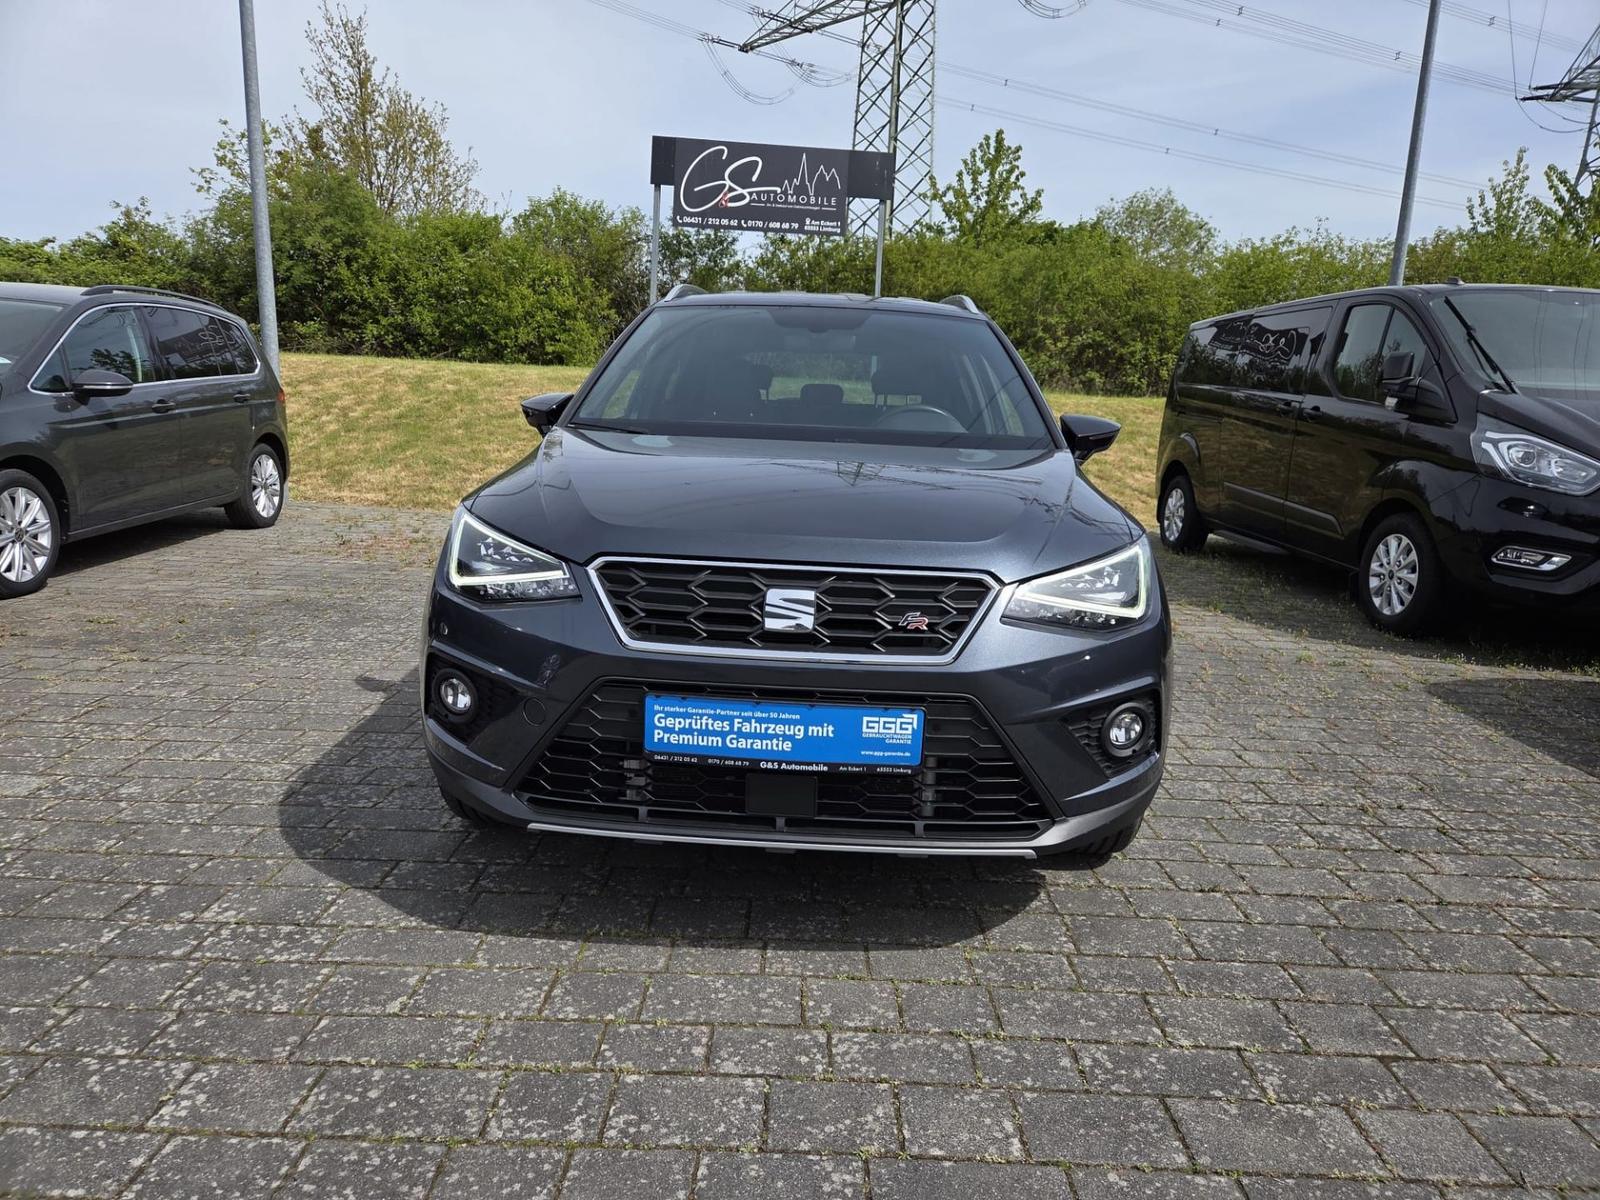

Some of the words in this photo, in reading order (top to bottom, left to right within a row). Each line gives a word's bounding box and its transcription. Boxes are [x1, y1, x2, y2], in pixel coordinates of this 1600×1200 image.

[751, 192, 838, 206] AUTOMOBILE
[683, 215, 702, 224] 06431
[708, 217, 720, 225] 212
[720, 218, 729, 226] 05
[747, 219, 763, 228] 0170
[898, 611, 929, 631] FR
[654, 704, 663, 712] Ihr
[687, 706, 740, 717] Garantie-Partner
[778, 712, 800, 720] Jahren
[654, 713, 730, 732] Geprüftes
[733, 718, 804, 739] Fahrzeug
[808, 723, 834, 738] mit
[862, 713, 918, 734] GGG
[654, 729, 722, 748] Premium
[726, 734, 792, 752] Garantie
[760, 761, 779, 770] G&S
[780, 762, 829, 772] Automobile
